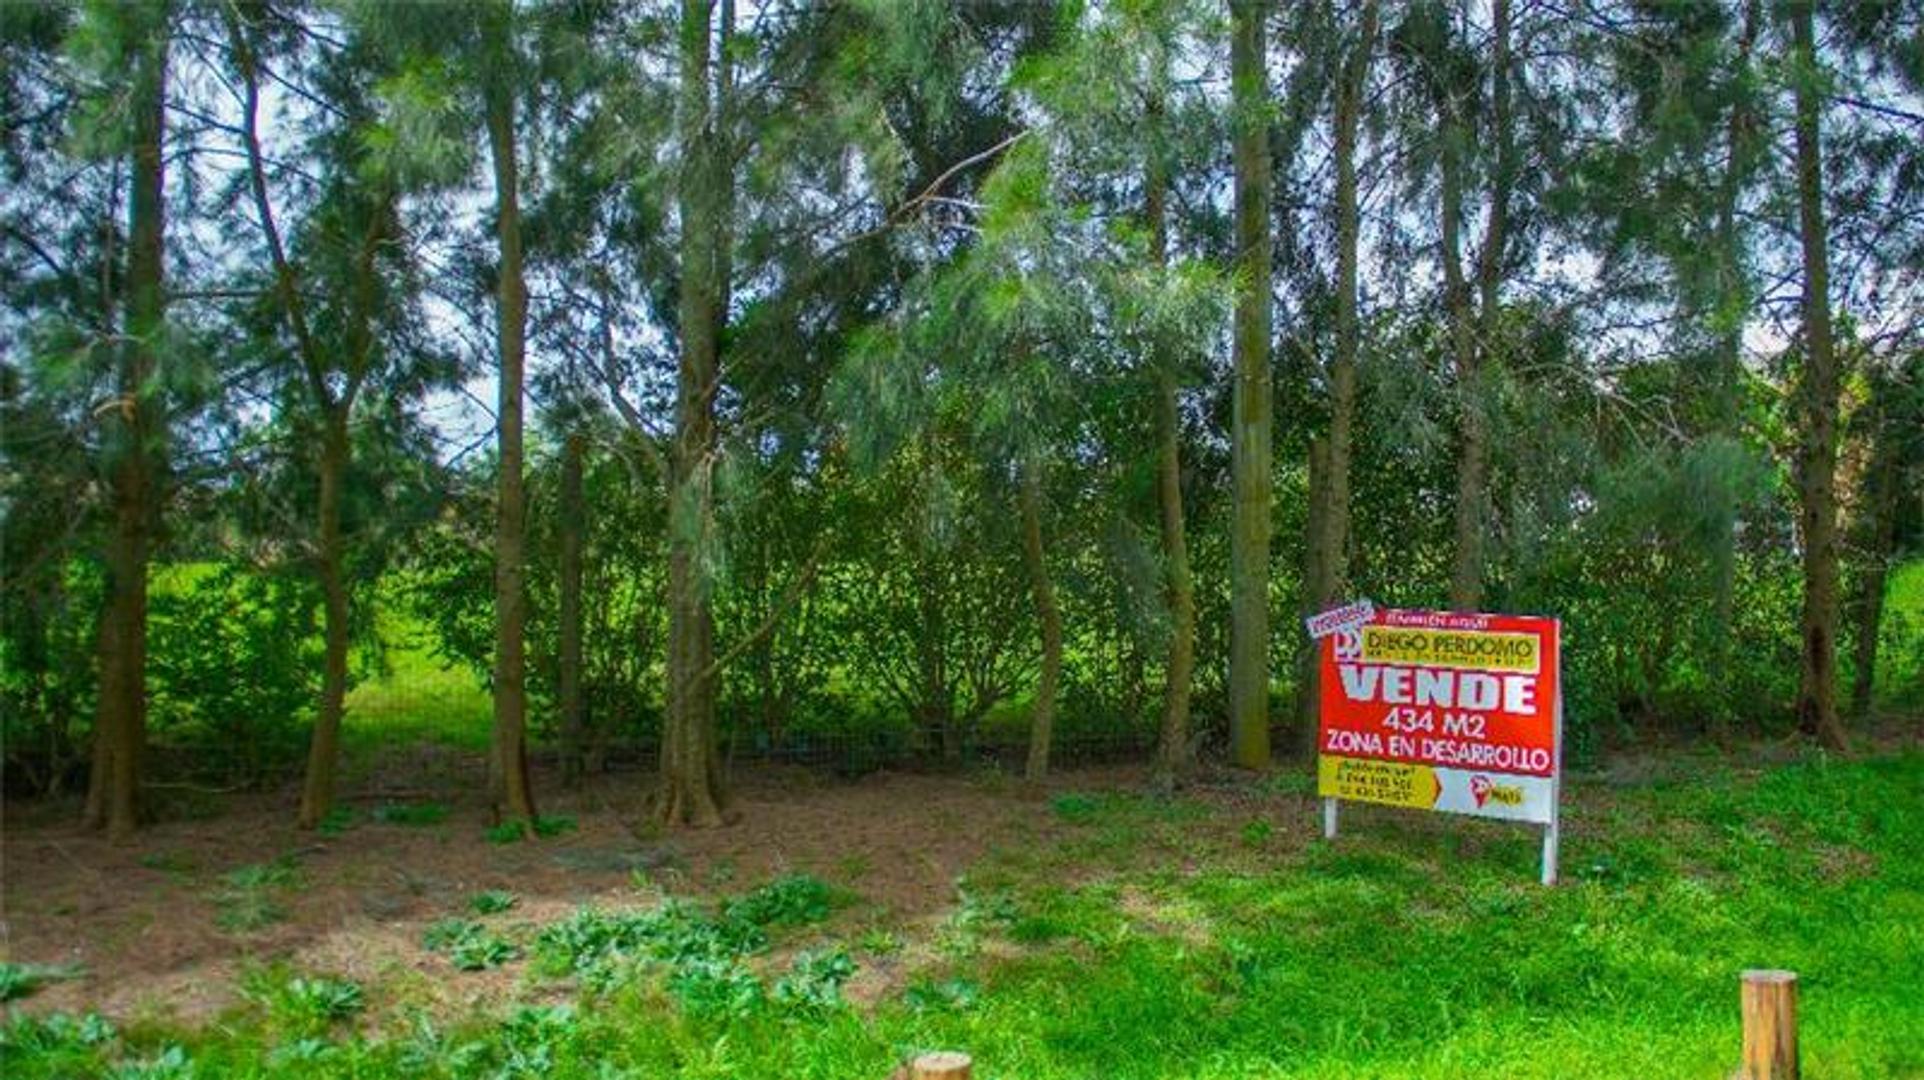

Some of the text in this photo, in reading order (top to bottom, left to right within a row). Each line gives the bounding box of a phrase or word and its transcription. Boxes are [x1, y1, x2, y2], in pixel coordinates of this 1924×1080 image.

[1368, 631, 1428, 651] DIEGO
[1433, 635, 1533, 658] PERDOMO
[1339, 664, 1537, 715] VENDE
[1382, 707, 1486, 739] 434 M2
[1327, 729, 1384, 755] ZONA
[1389, 736, 1415, 757] EN
[1421, 739, 1550, 771] DESARROLLO
